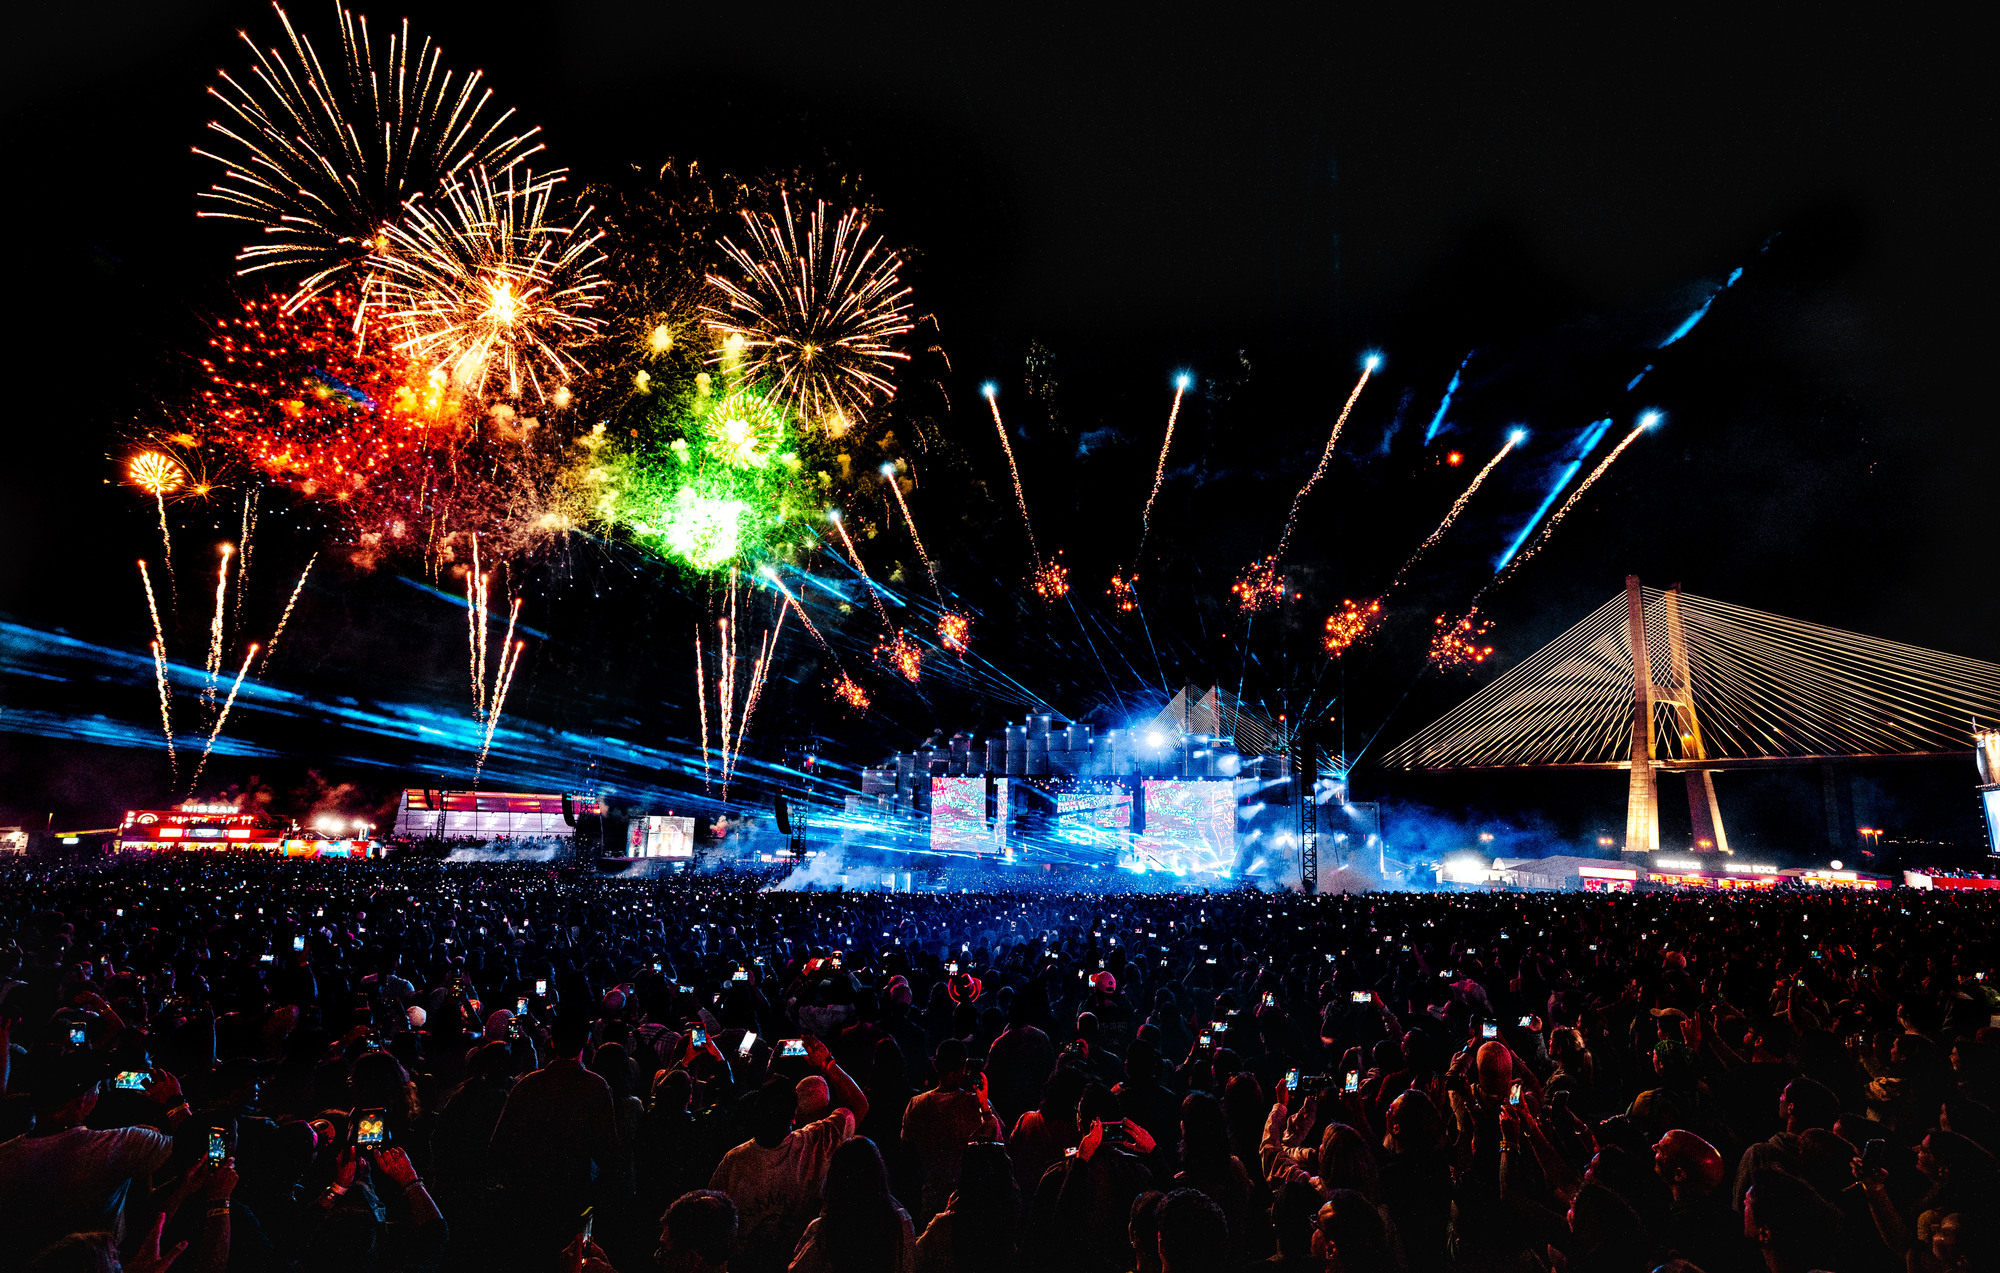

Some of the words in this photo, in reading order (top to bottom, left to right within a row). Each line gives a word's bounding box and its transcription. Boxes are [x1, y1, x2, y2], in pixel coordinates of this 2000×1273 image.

[182, 805, 239, 814] NISSAN
[1657, 860, 1680, 868] SUPER
[1680, 861, 1701, 870] BOCK
[1725, 864, 1751, 873] SUPER
[1752, 865, 1778, 875] BOCK
